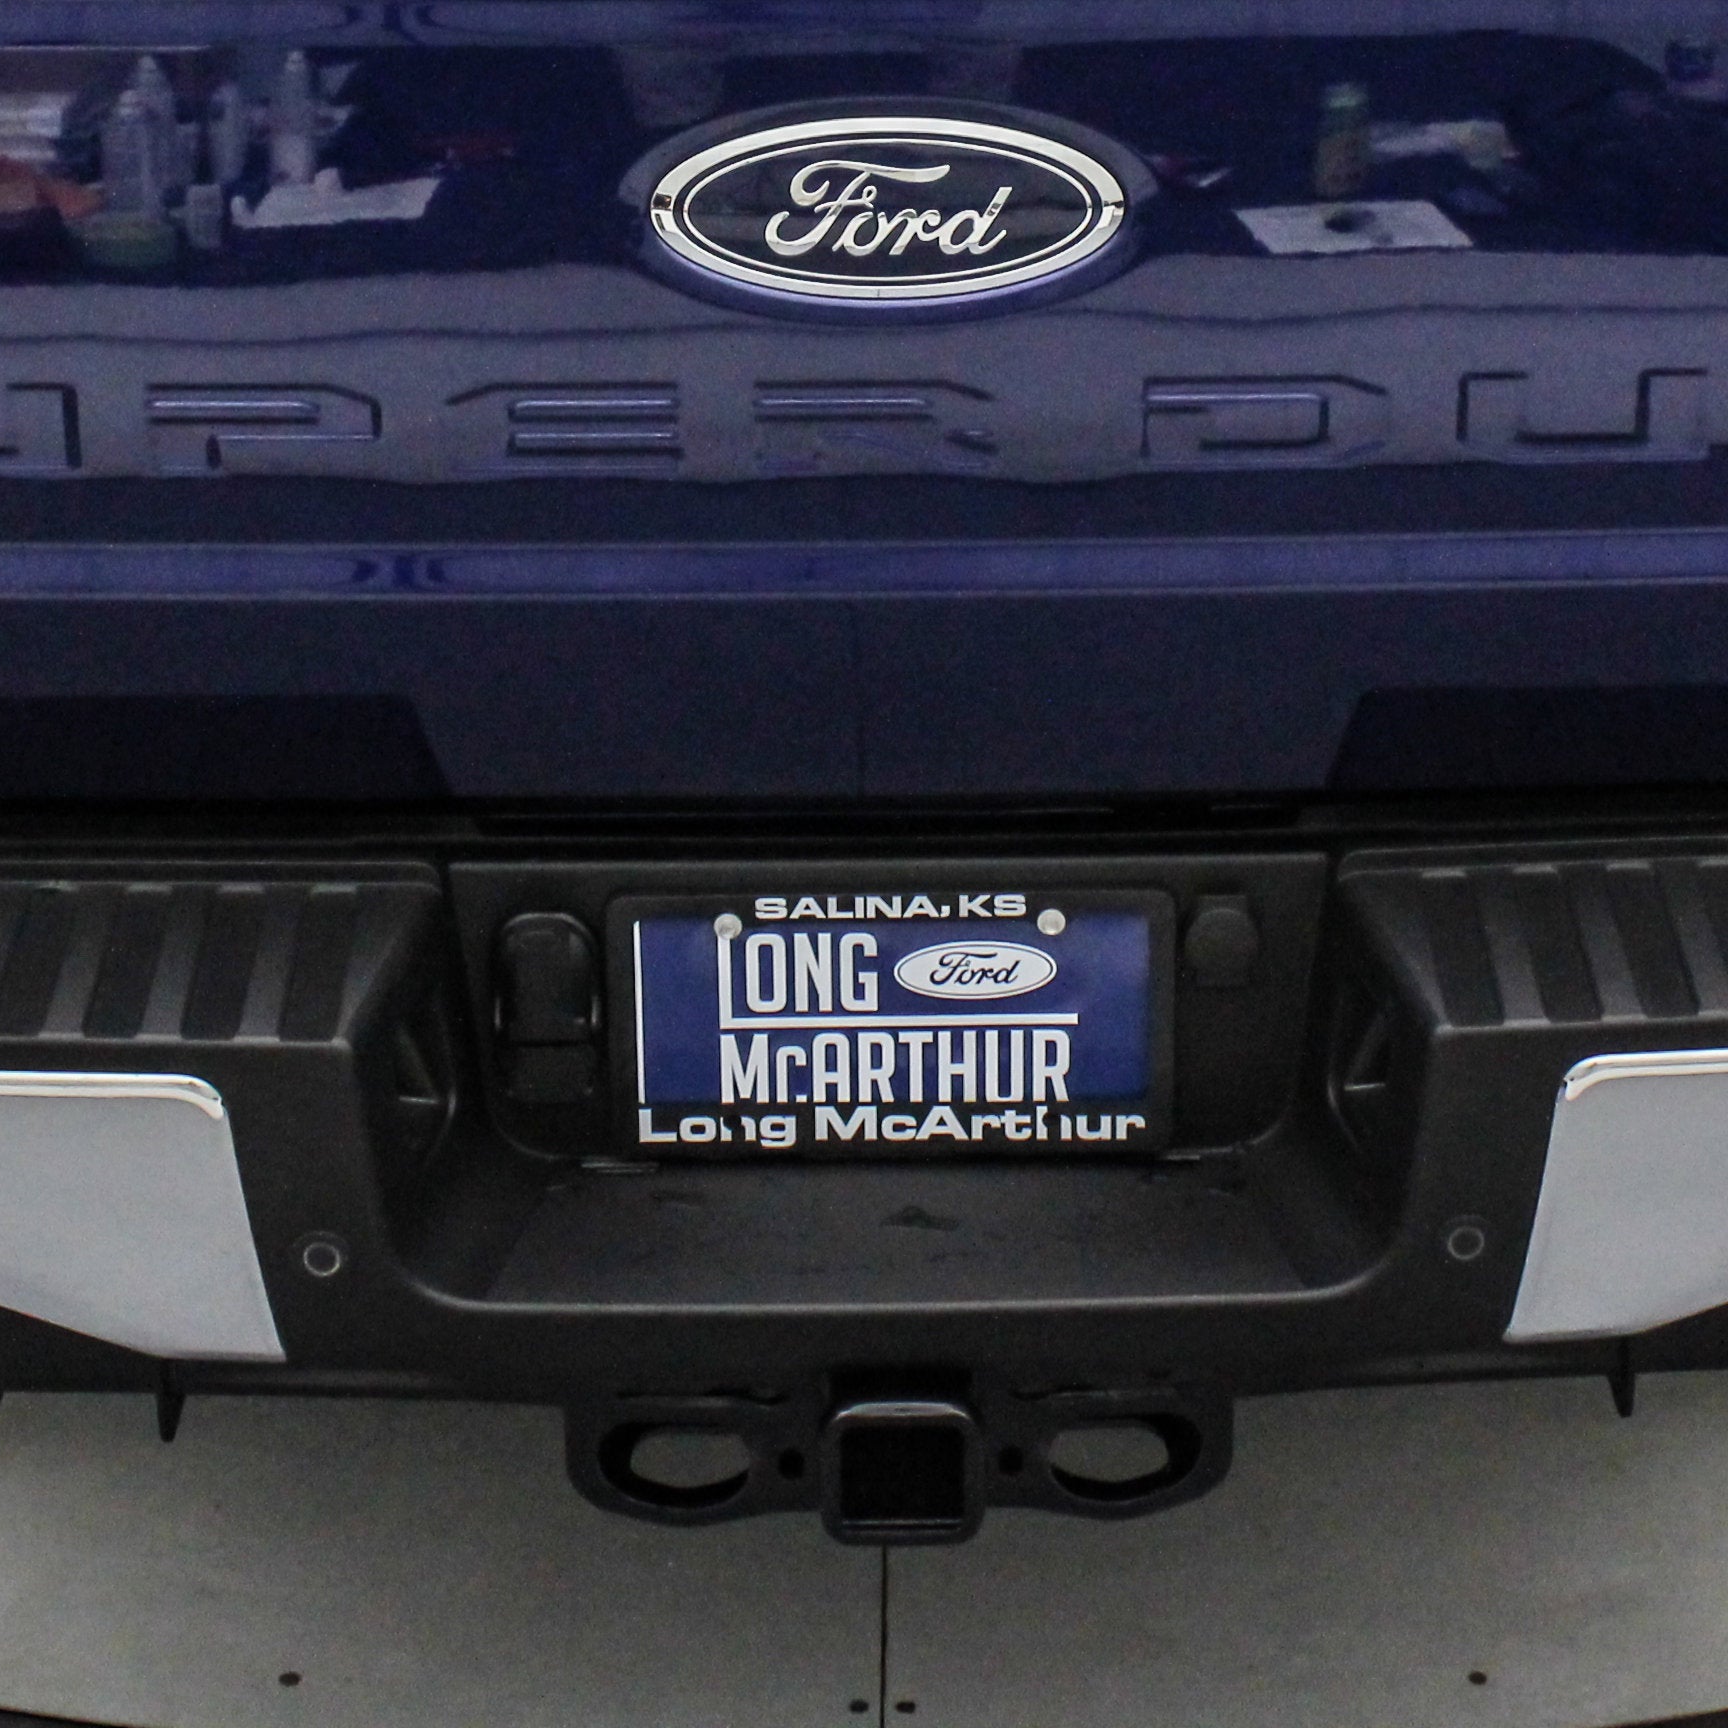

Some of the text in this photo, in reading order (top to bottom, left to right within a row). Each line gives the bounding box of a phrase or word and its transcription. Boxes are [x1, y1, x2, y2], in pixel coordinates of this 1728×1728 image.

[764, 159, 1013, 257] Ford
[754, 894, 1027, 919] SALINA, KS
[717, 931, 880, 1030] LONG
[928, 951, 1019, 986] Ford
[719, 1028, 1071, 1104] McARTHUR
[638, 1104, 1147, 1149] Long McArthur
